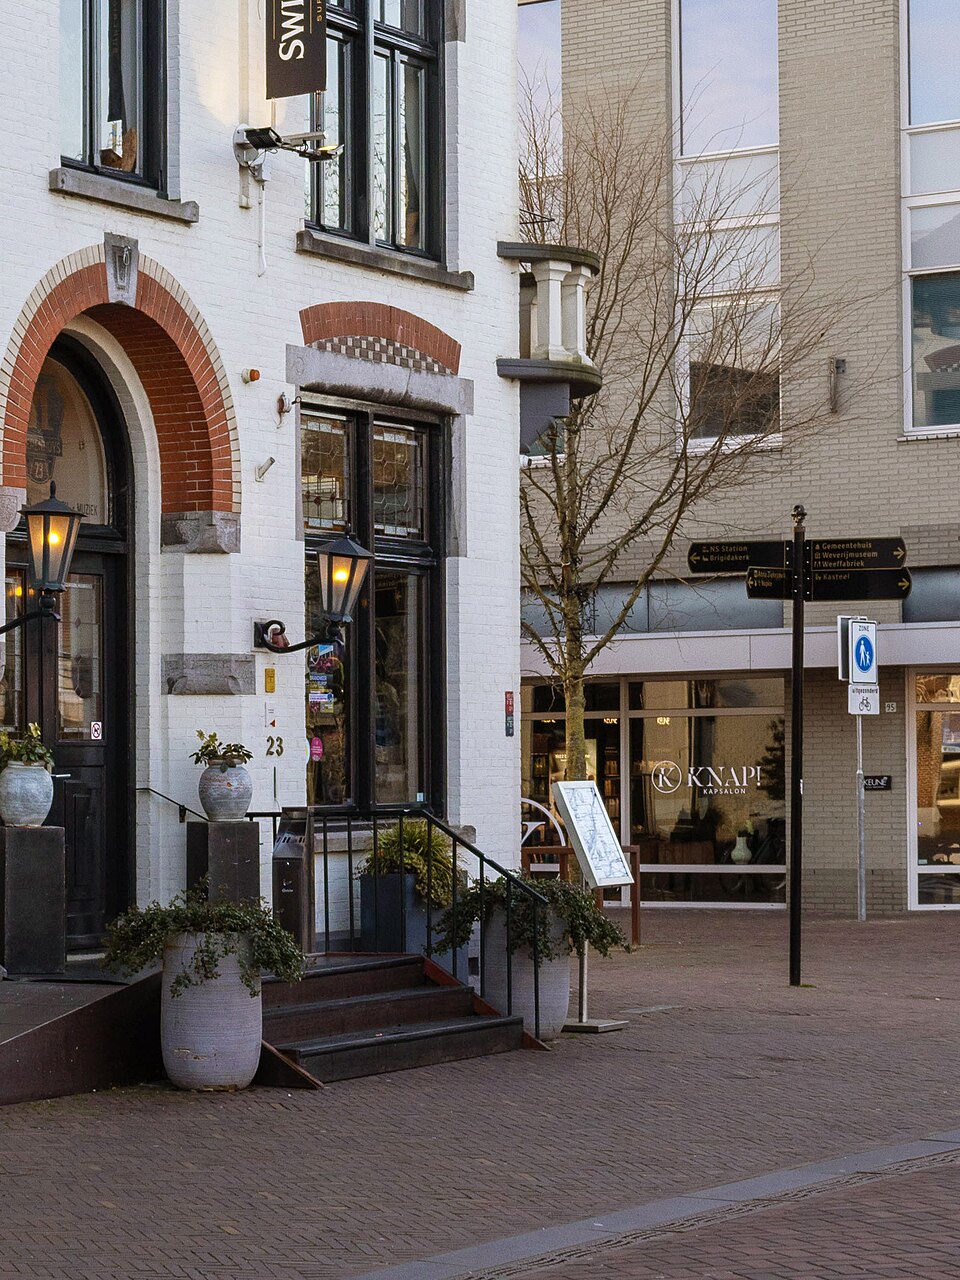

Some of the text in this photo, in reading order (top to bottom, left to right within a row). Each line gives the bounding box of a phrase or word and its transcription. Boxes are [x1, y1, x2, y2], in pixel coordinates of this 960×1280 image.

[822, 542, 872, 550] Gemeentehuis
[710, 554, 750, 562] Brigidakerk
[822, 551, 878, 559] Weverijmuseum
[266, 735, 283, 756] 23
[658, 767, 675, 787] K
[687, 766, 762, 787] KNAP!
[863, 776, 888, 786] KEUNE
